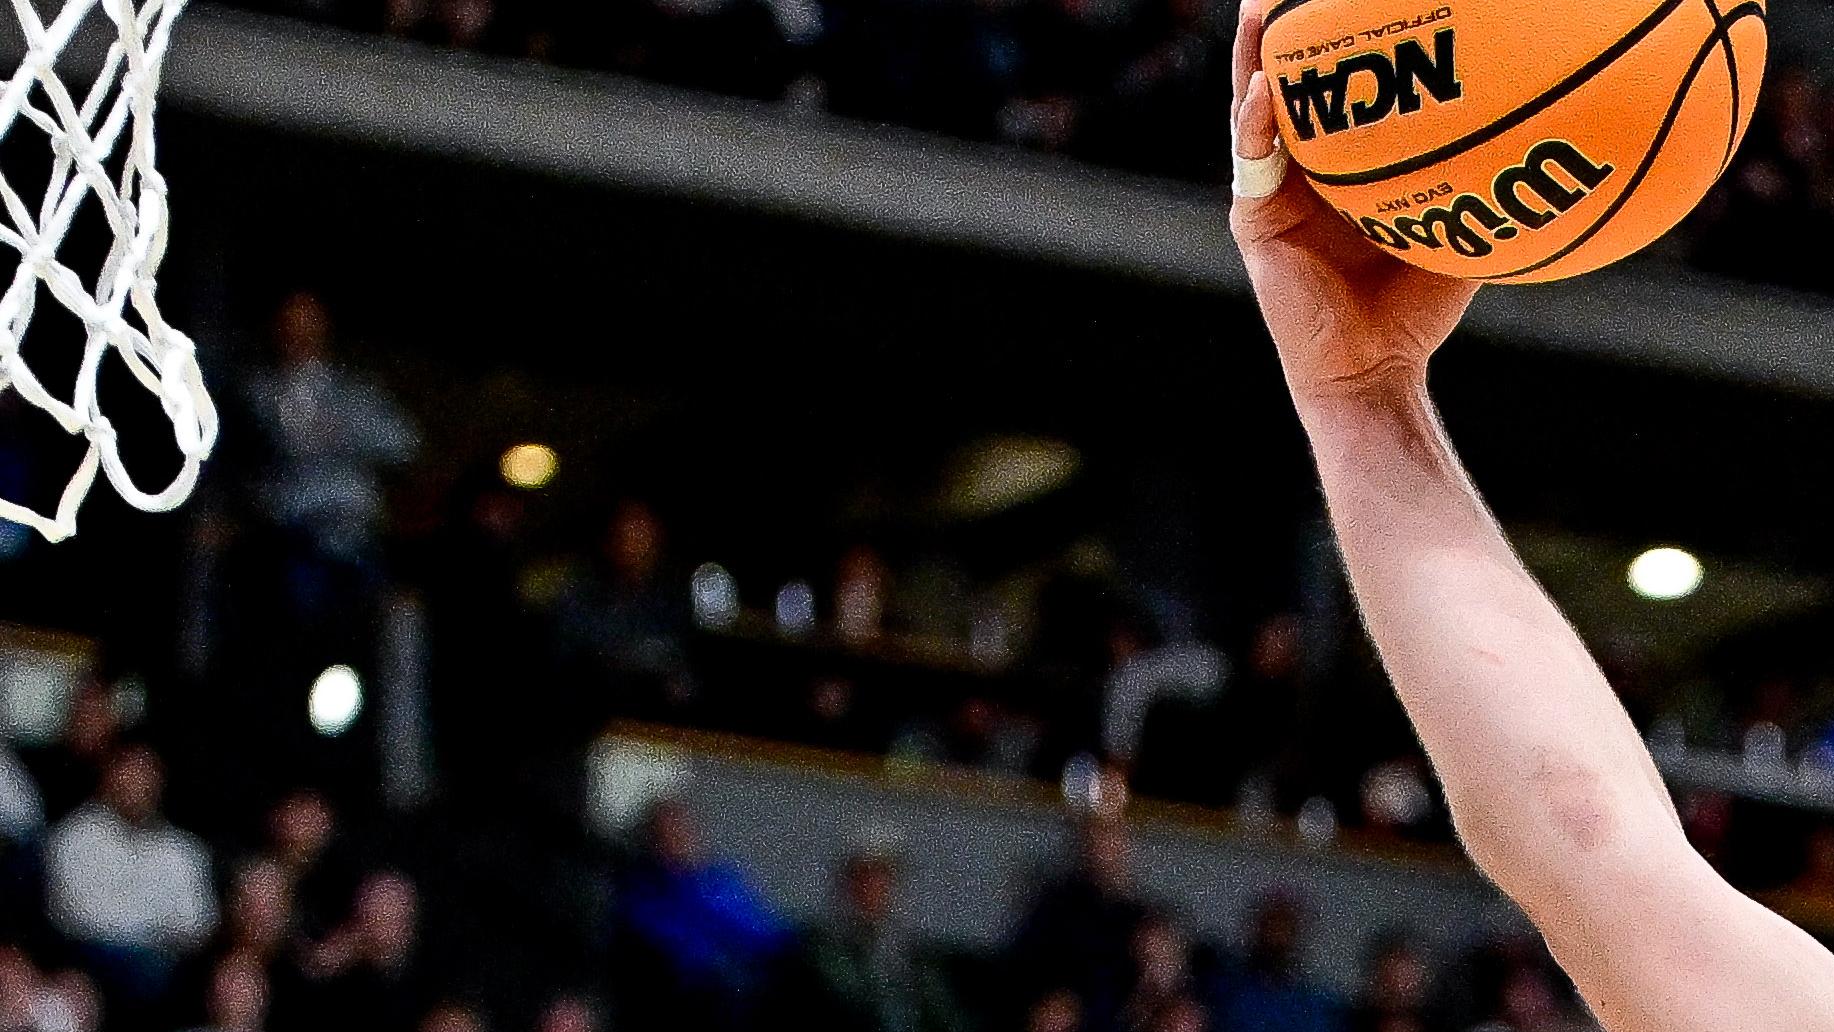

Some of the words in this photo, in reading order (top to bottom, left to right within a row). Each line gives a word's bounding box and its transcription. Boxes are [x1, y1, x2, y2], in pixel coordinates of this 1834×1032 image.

[1307, 34, 1355, 59] GAME
[1358, 6, 1452, 41] OFFICIAL
[1278, 27, 1463, 142] NCAA
[1338, 139, 1615, 258] Wilso
